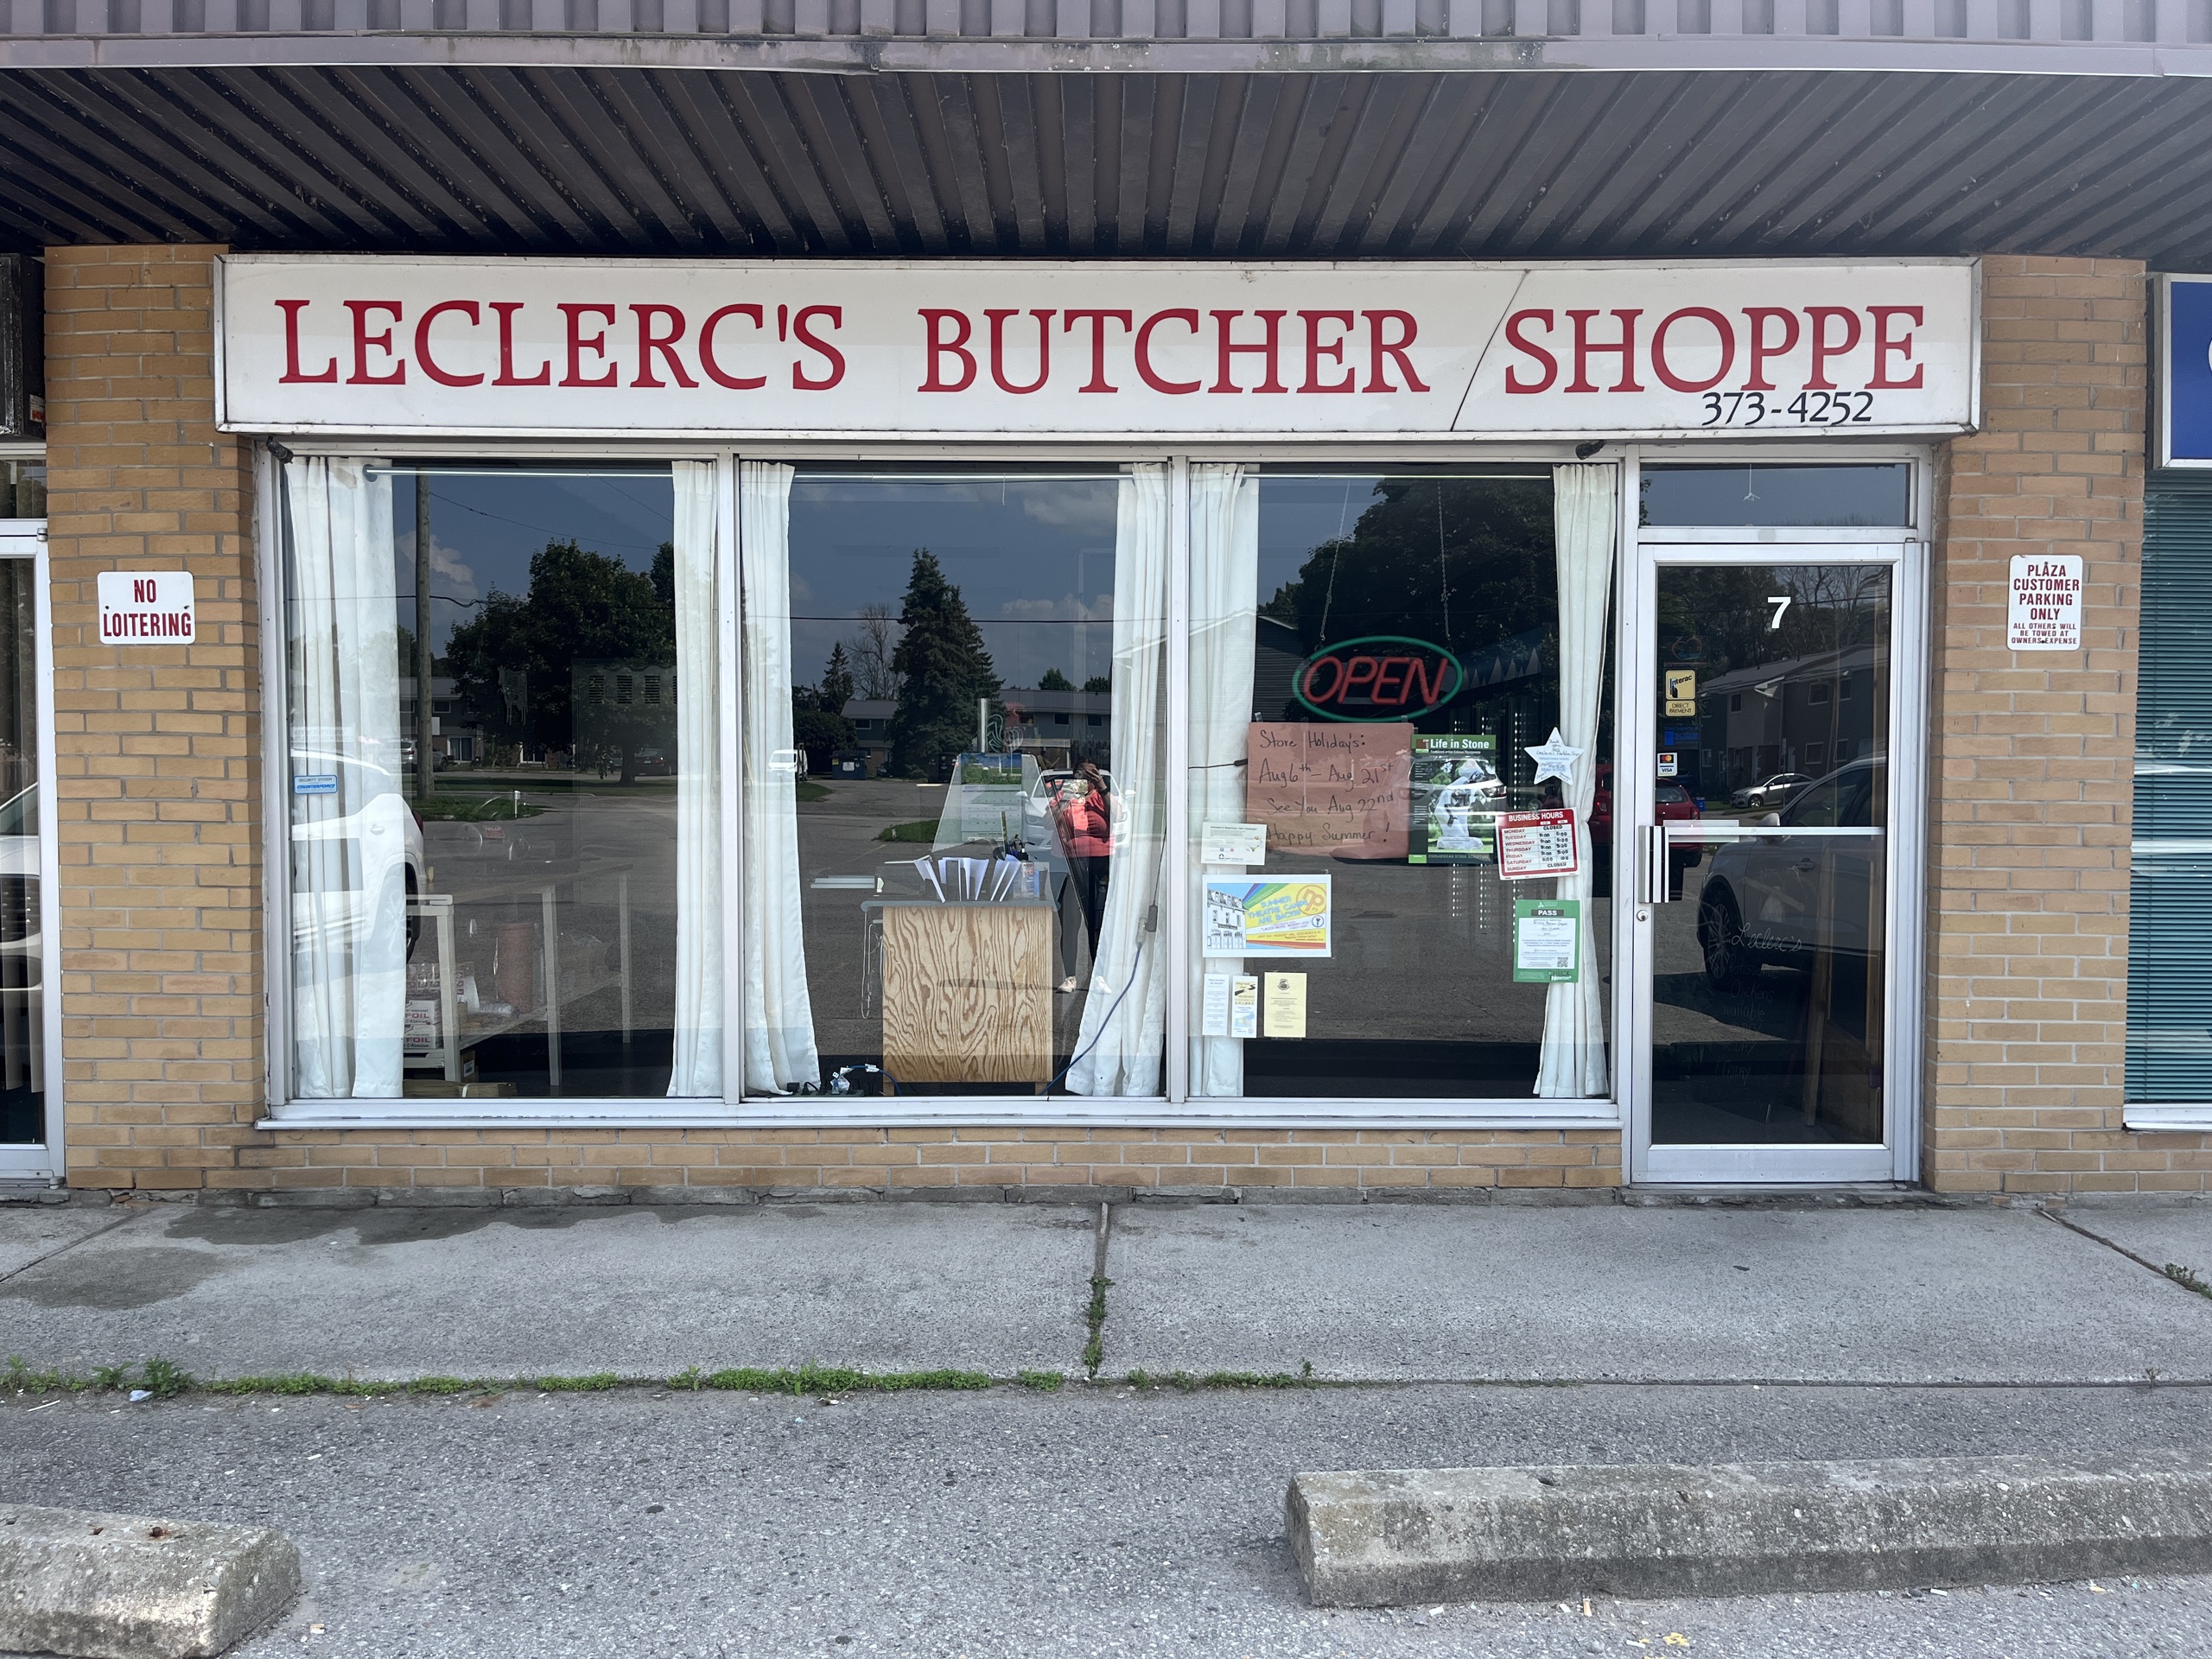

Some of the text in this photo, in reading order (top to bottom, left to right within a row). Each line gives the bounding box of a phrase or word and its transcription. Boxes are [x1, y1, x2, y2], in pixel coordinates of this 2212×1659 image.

[274, 299, 1924, 394] LECLERC'S BUTCHER SHOPPE
[1700, 391, 1874, 426] 373-4252
[2027, 564, 2067, 577] PLAZA
[133, 579, 157, 604] NO
[2013, 578, 2080, 591] CUSTOMER
[2018, 593, 2073, 606] PARKING
[103, 612, 192, 637] LOITERING
[1766, 596, 1792, 630] 7
[2030, 607, 2061, 620] ONLY
[1303, 655, 1449, 706] OPEN
[1259, 728, 1298, 748] Store
[1430, 738, 1448, 749] Life
[1450, 738, 1459, 748] in
[1462, 738, 1490, 749] Stone
[1328, 764, 1354, 792] Aug
[1360, 763, 1395, 785] 21st
[1267, 790, 1394, 823] See You Aug 22nd
[1508, 810, 1564, 822] BUSINESS HOURS
[1266, 823, 1313, 846] Happy
[1322, 822, 1376, 841] Summer
[1731, 922, 1802, 951] Leclerc's
